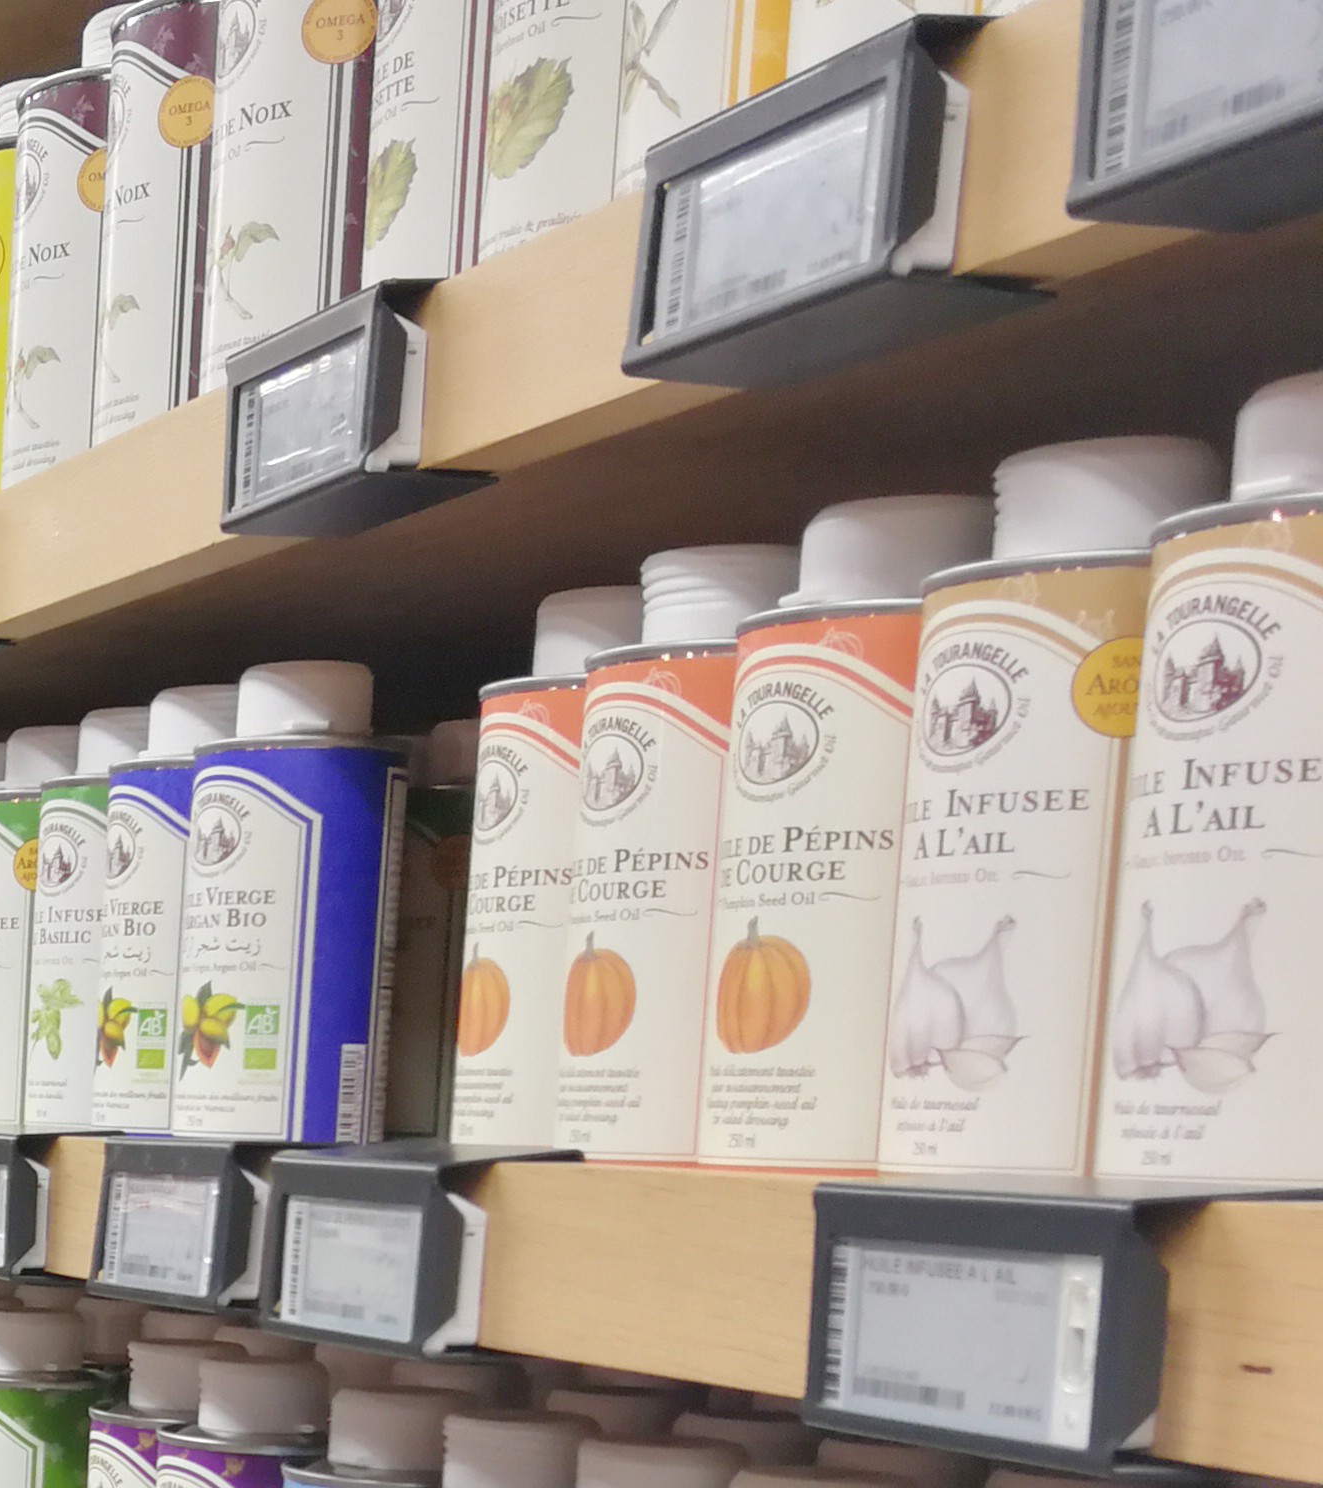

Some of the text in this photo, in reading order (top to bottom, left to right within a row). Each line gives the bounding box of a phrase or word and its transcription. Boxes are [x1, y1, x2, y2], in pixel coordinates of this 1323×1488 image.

[316, 13, 365, 29] OMEGA
[336, 29, 344, 41] 3
[393, 51, 415, 74] DE
[239, 100, 293, 130] NOIX
[115, 182, 151, 207] NOIX
[29, 242, 71, 267] NOIX
[1165, 595, 1283, 642] TOURANGELLE
[932, 641, 1030, 685] TOURANGELLE
[749, 681, 835, 721] TOURANGELLE
[589, 716, 654, 752] TOURANGELLE
[1184, 756, 1323, 791] INFUSE
[947, 787, 1090, 818] INFUSEE
[1169, 799, 1267, 835] L'AIL
[749, 825, 895, 855] DE PÉPINS
[937, 826, 1016, 858] L'AIL
[614, 848, 709, 874] PÉPINS
[735, 859, 846, 886] COURGE
[493, 862, 573, 889] PÉPINS
[206, 886, 276, 907] VIERGE
[577, 879, 667, 902] COURGE
[790, 890, 816, 907] Oil
[48, 906, 103, 924] INFUSE
[110, 899, 164, 918] VIERGE
[226, 909, 267, 929] BIO
[39, 928, 91, 946] BASILIC
[123, 918, 156, 938] BIO
